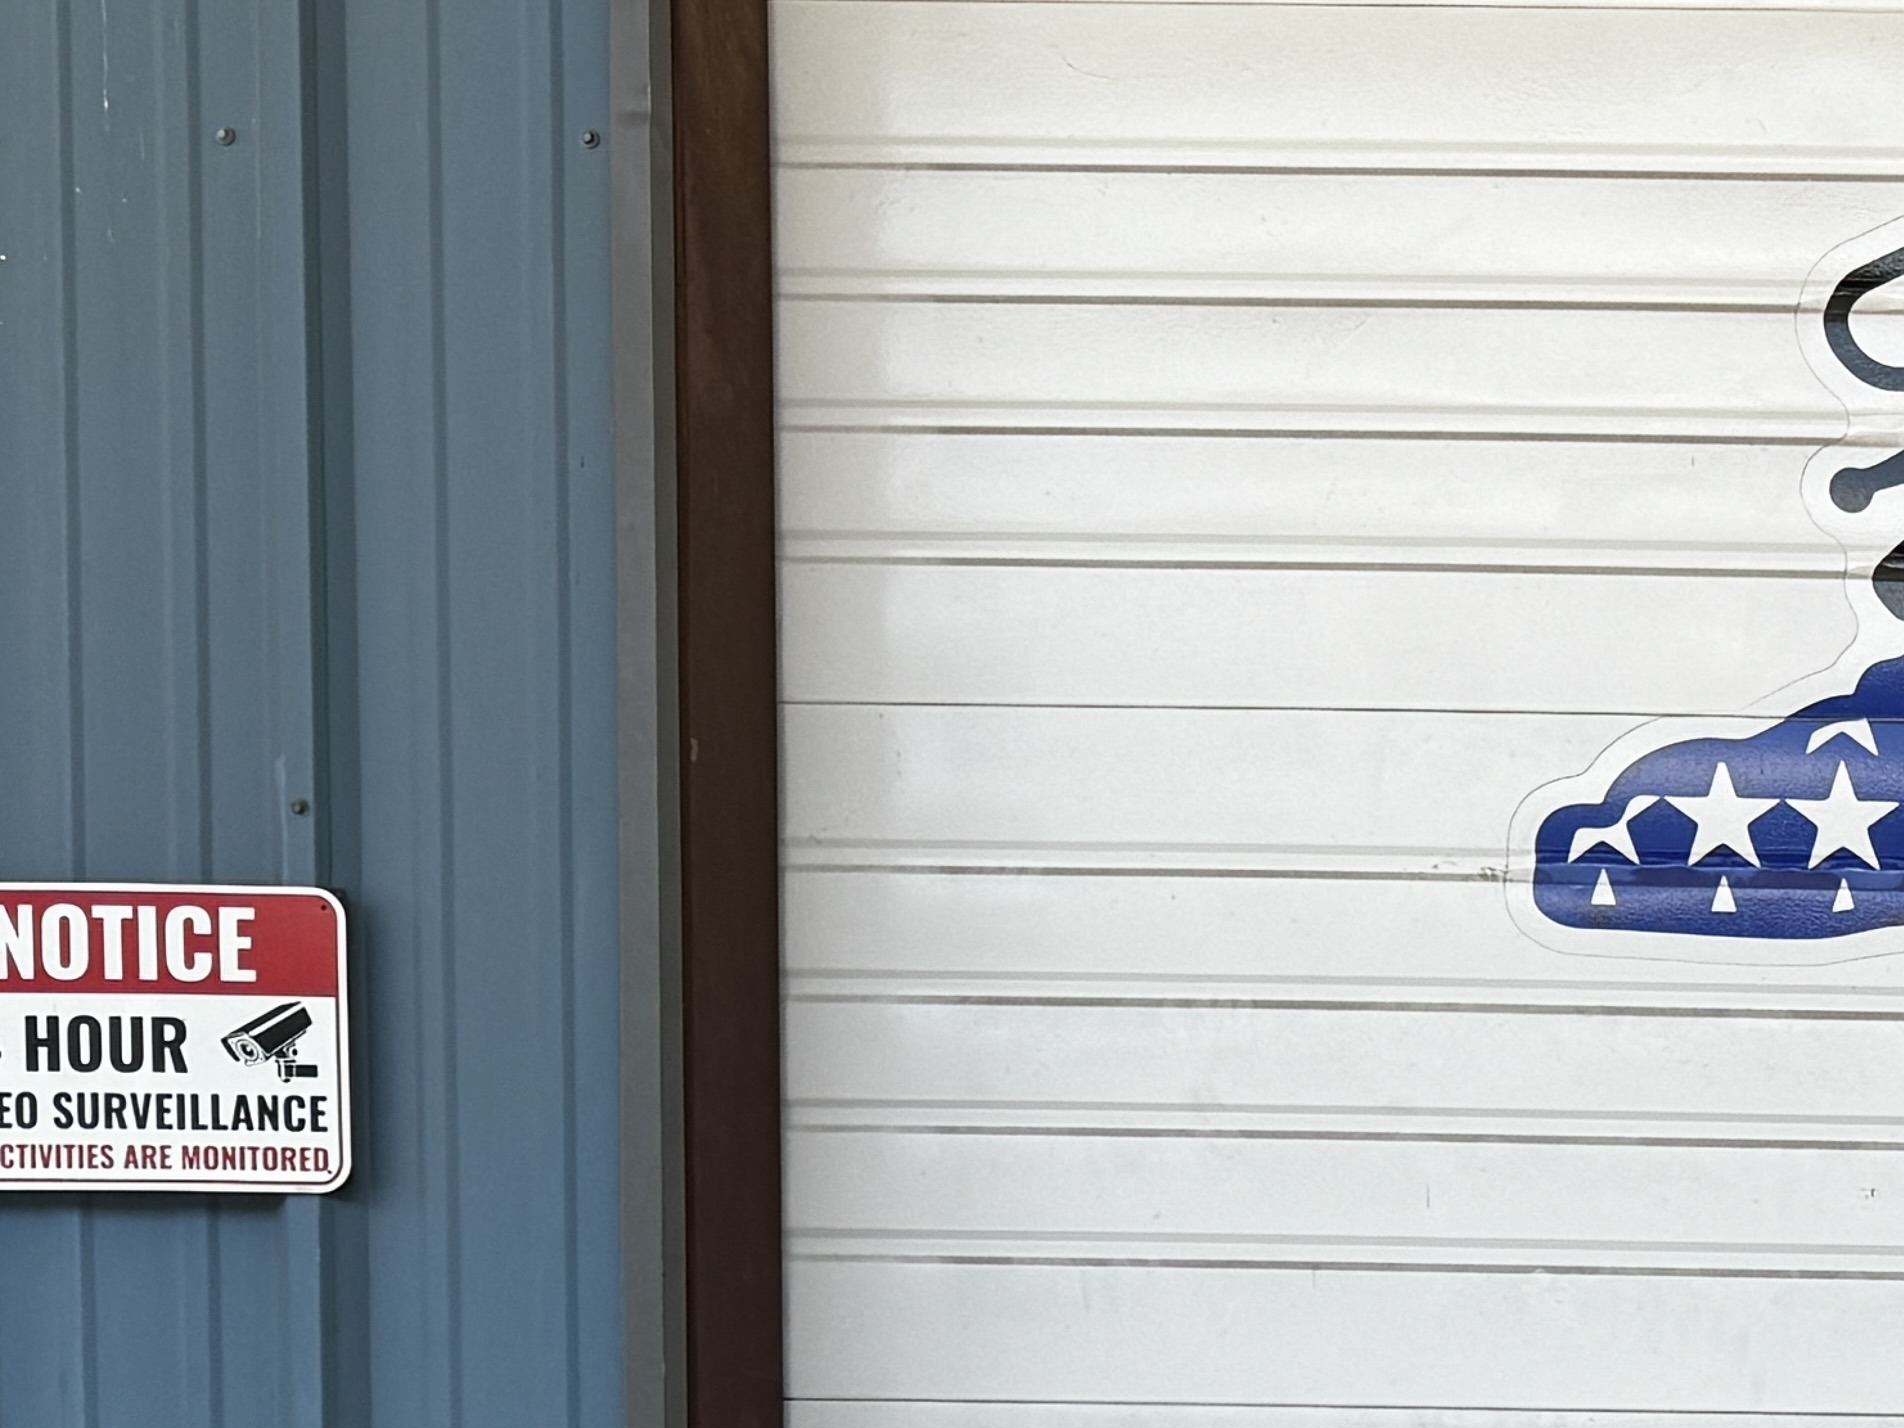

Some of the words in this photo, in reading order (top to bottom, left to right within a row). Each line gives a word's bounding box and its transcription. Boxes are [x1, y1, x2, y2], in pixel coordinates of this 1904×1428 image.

[0, 903, 257, 983] NOTICE
[25, 1014, 189, 1074] HOUR
[53, 1091, 329, 1133] SURVEILLANCE
[124, 1145, 173, 1170] ARE
[182, 1146, 330, 1172] MONITORED
